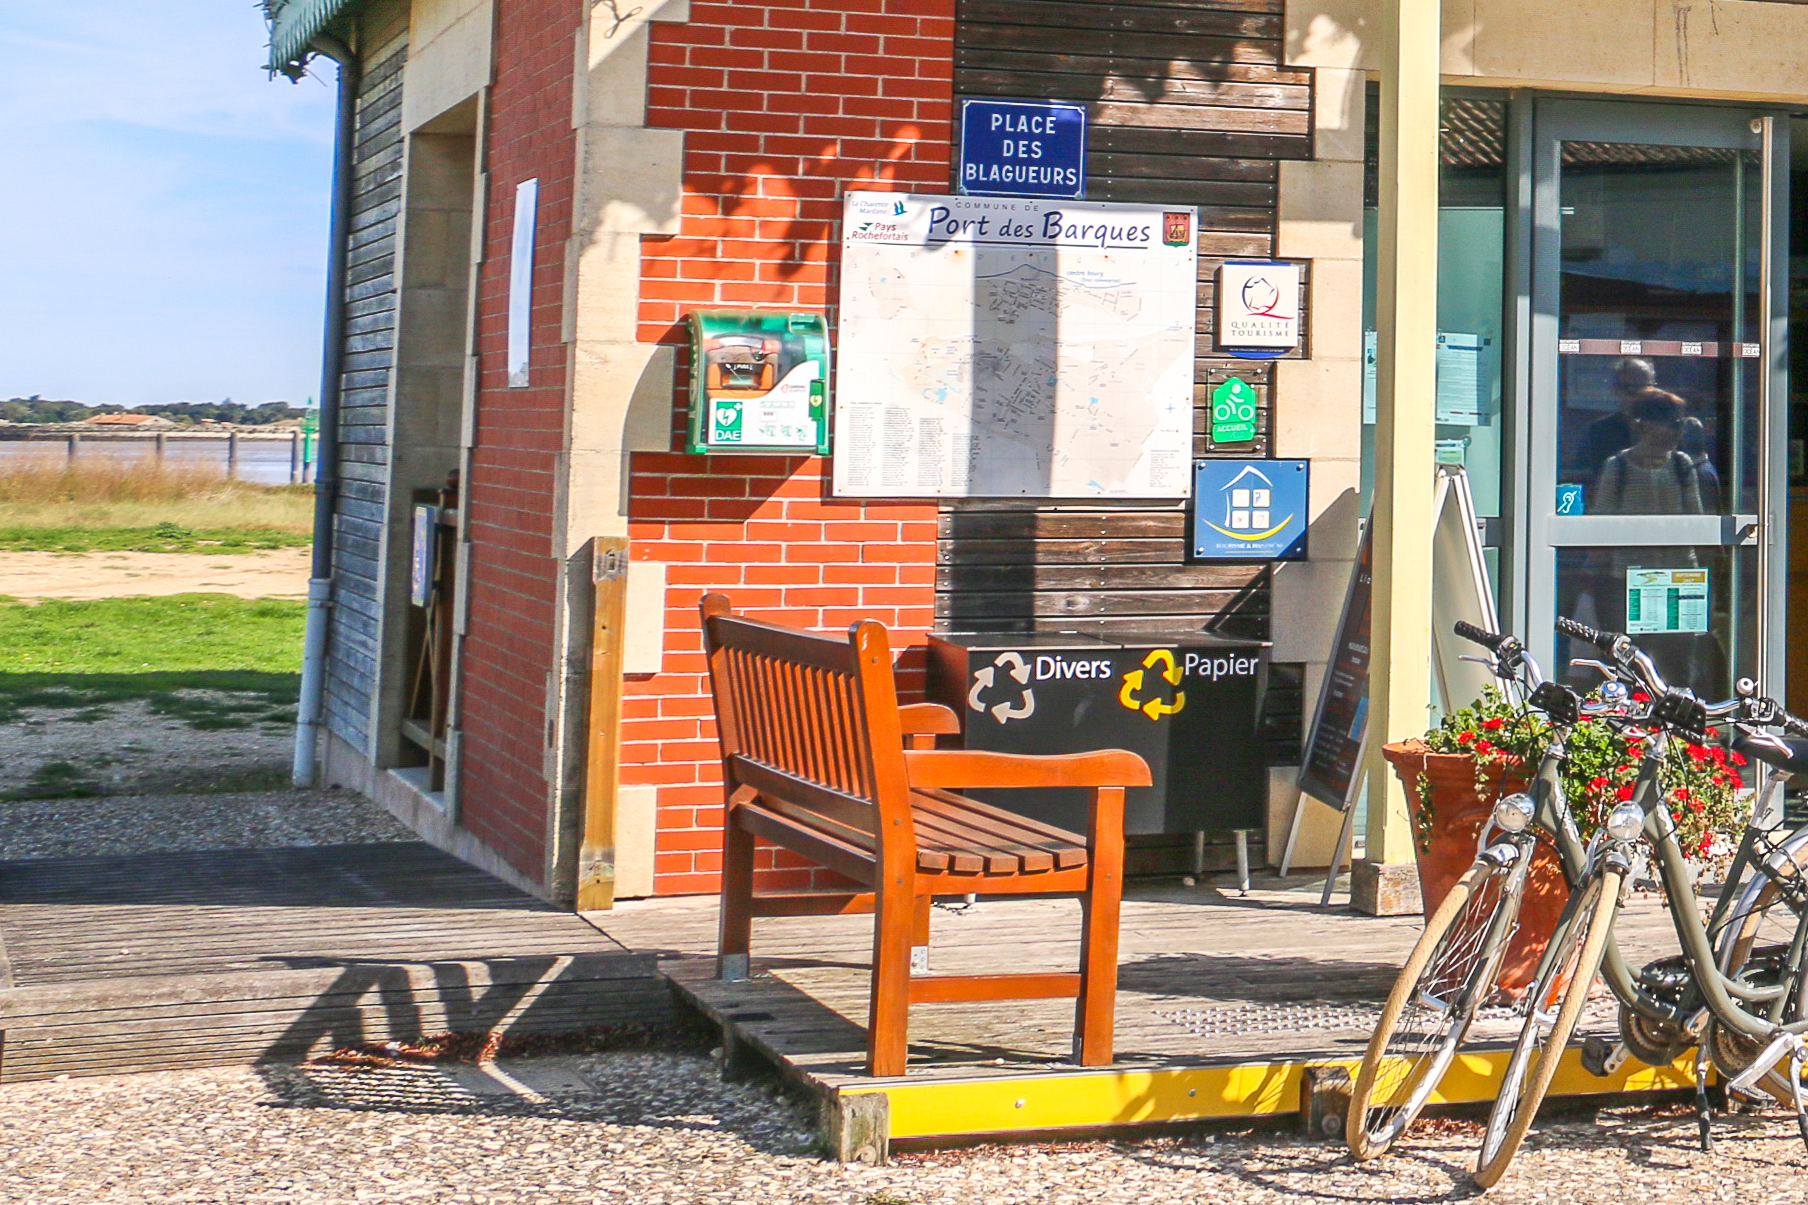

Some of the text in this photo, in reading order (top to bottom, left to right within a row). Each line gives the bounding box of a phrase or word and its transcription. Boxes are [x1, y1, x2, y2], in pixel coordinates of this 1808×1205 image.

[991, 113, 1057, 134] PLACE
[1003, 139, 1042, 158] DES
[966, 163, 1077, 185] BLAGUEURS
[956, 202, 1016, 210] COMMUNE
[875, 222, 897, 232] Pays
[928, 206, 1150, 247] Port des Barques
[852, 230, 908, 241] Rochefortais
[1231, 320, 1289, 329] QUALITÉ
[1216, 423, 1248, 432] ACCUEIL
[715, 430, 741, 441] DAE
[1035, 656, 1111, 680] Divers
[1185, 653, 1259, 681] Papier
